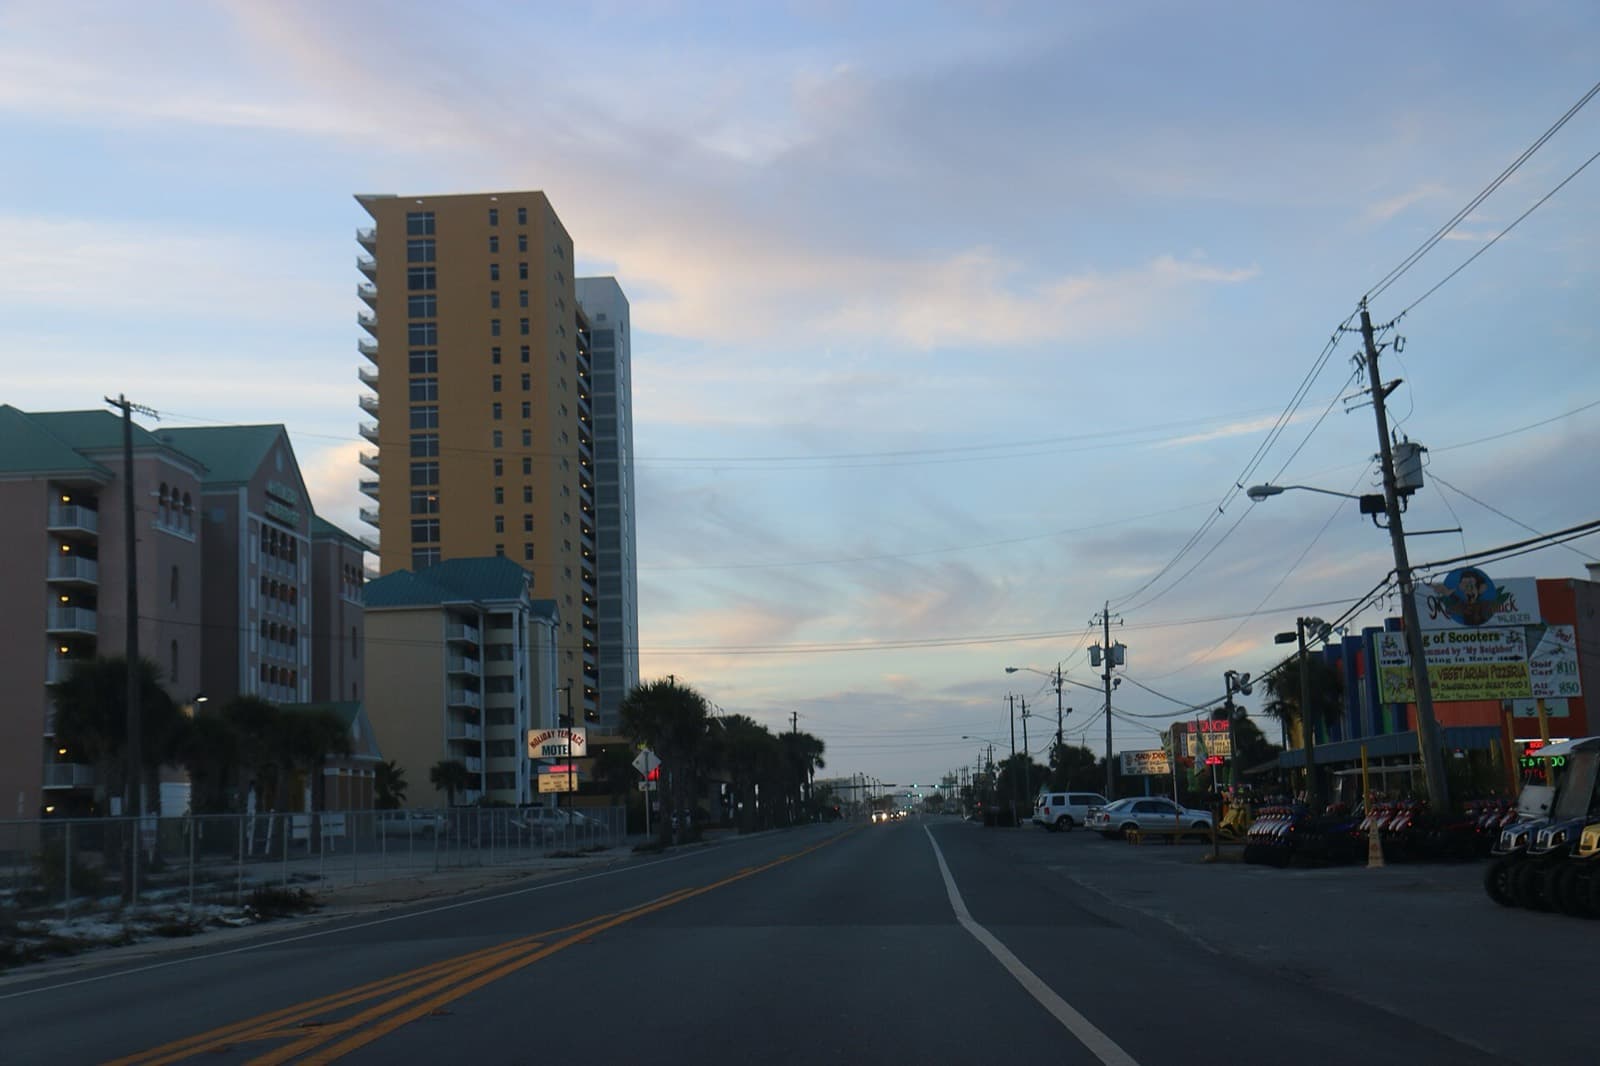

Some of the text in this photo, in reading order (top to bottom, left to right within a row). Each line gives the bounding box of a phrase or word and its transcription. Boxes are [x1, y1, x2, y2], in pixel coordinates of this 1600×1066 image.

[1433, 632, 1445, 643] of
[1448, 631, 1500, 643] Scooters
[529, 730, 584, 749] HOLIDAY TERACE
[542, 745, 570, 756] MOTE
